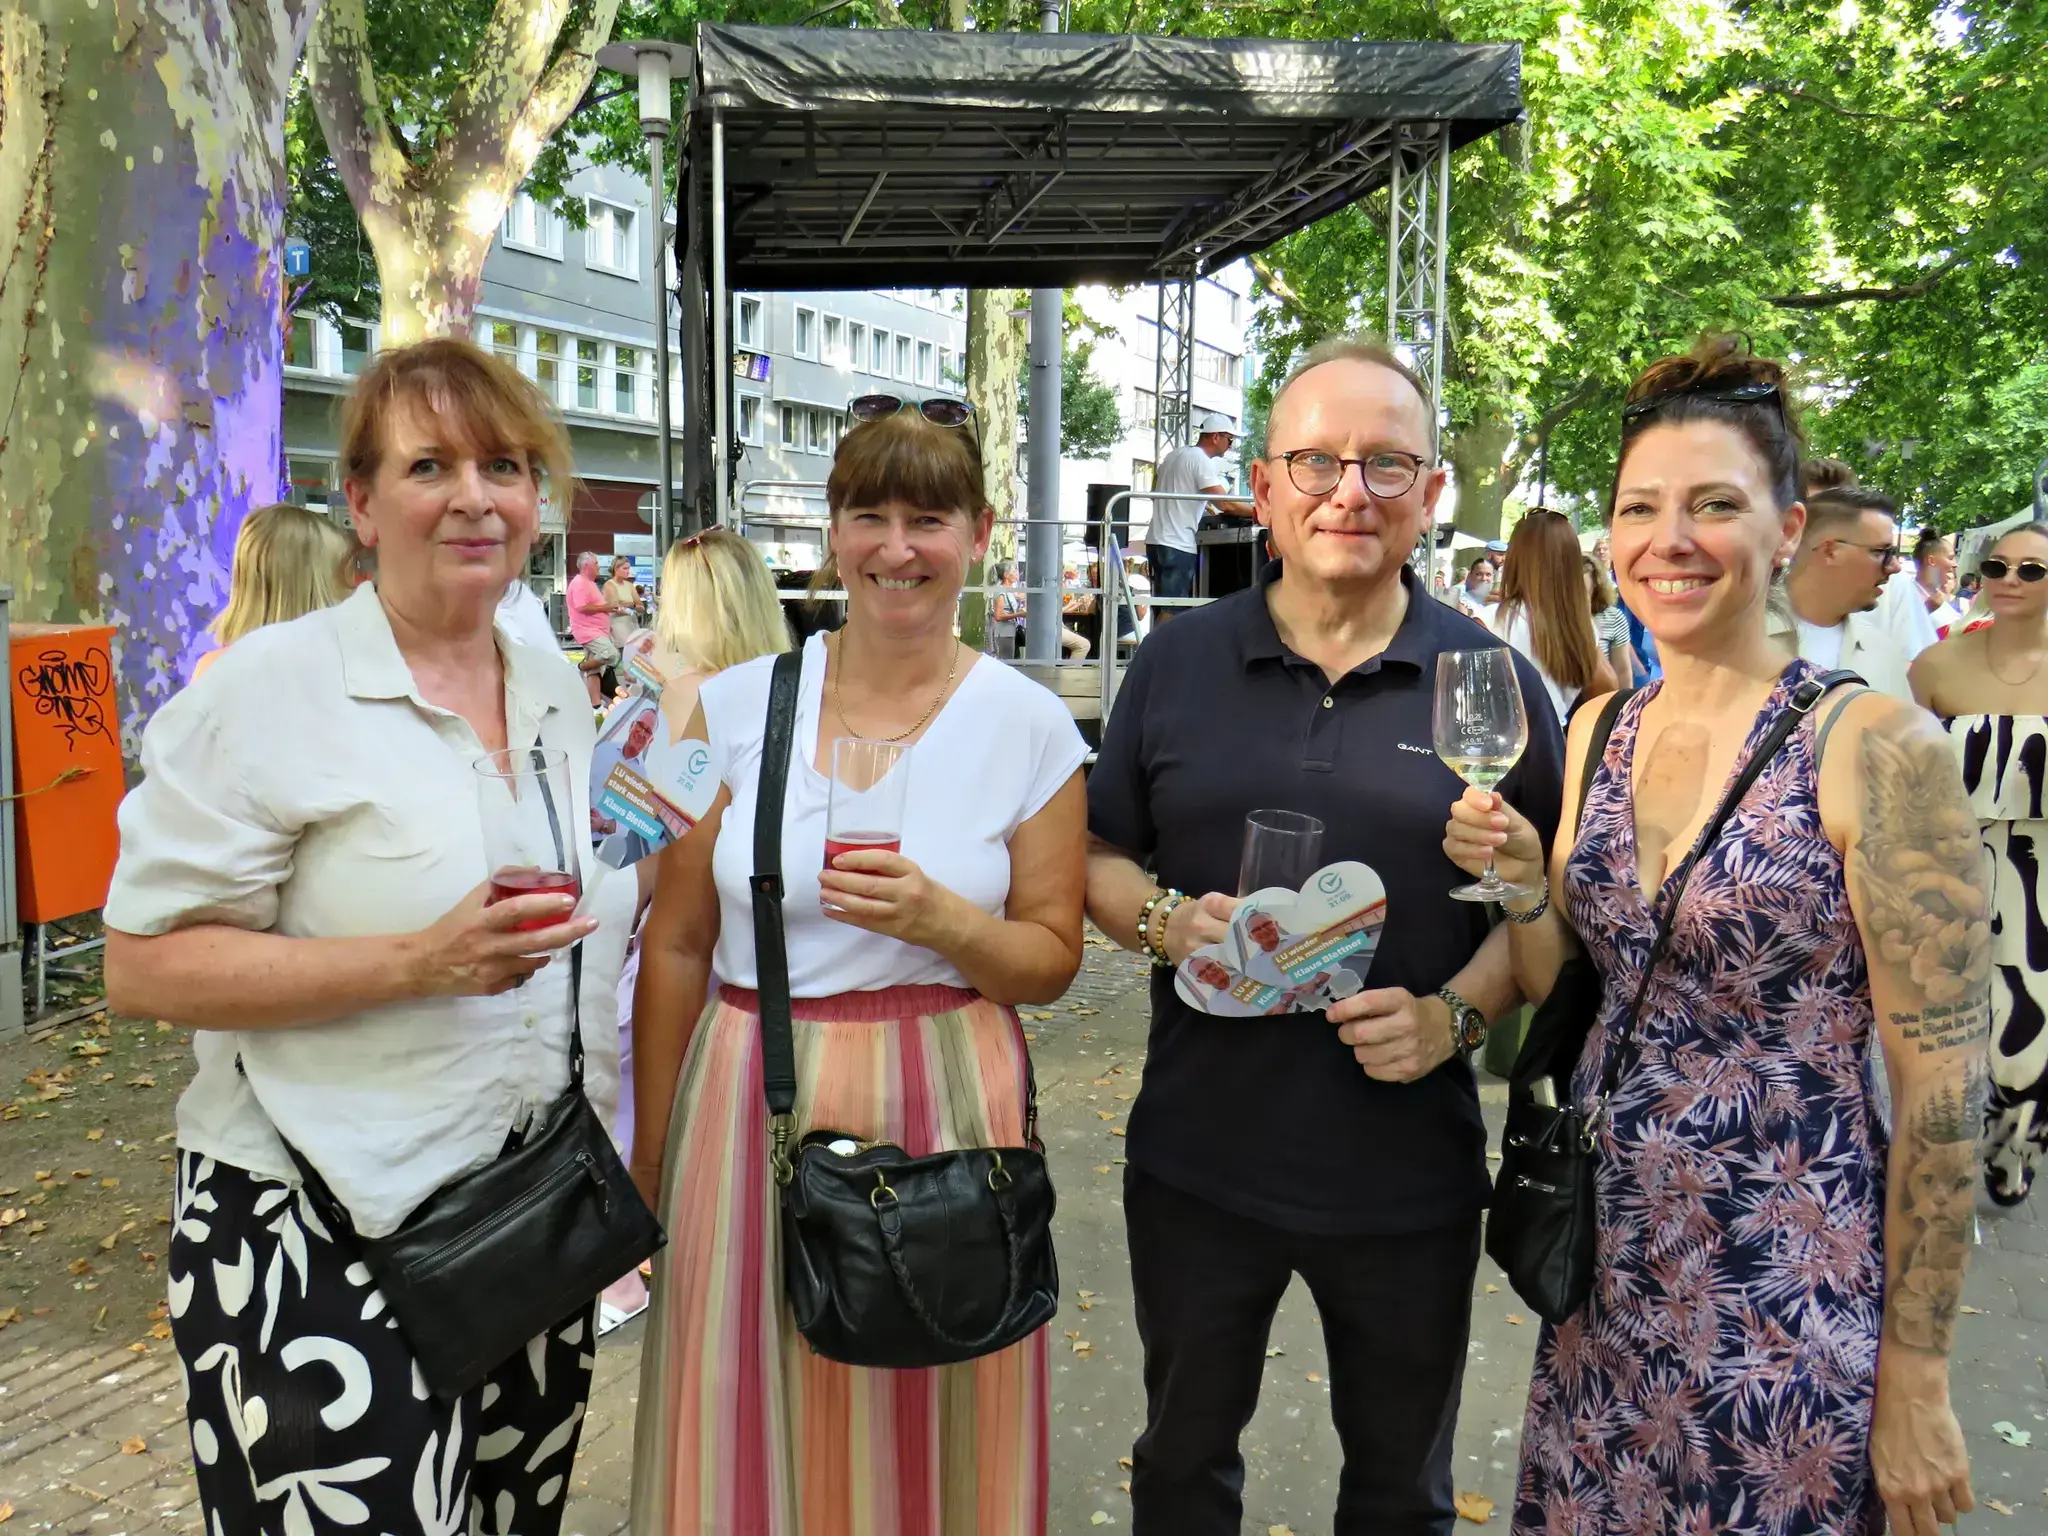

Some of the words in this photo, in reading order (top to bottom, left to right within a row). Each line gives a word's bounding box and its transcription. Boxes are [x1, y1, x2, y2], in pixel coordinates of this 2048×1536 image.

[291, 250, 304, 271] T
[1397, 743, 1434, 756] GANT
[613, 766, 625, 779] LU
[624, 775, 648, 795] wieder
[607, 778, 630, 797] stark
[626, 791, 655, 816] machen.
[603, 796, 627, 817] Klaus
[625, 810, 658, 837] Blettner
[1275, 953, 1288, 963] LU
[1288, 936, 1319, 956] wieder
[1280, 955, 1305, 971] stark
[1304, 935, 1343, 958] machen.
[1293, 961, 1323, 979] Klaus
[1321, 938, 1362, 963] Blettner
[1232, 986, 1245, 997] LU
[1242, 983, 1263, 1003] stark
[1257, 987, 1280, 1006] Klau
